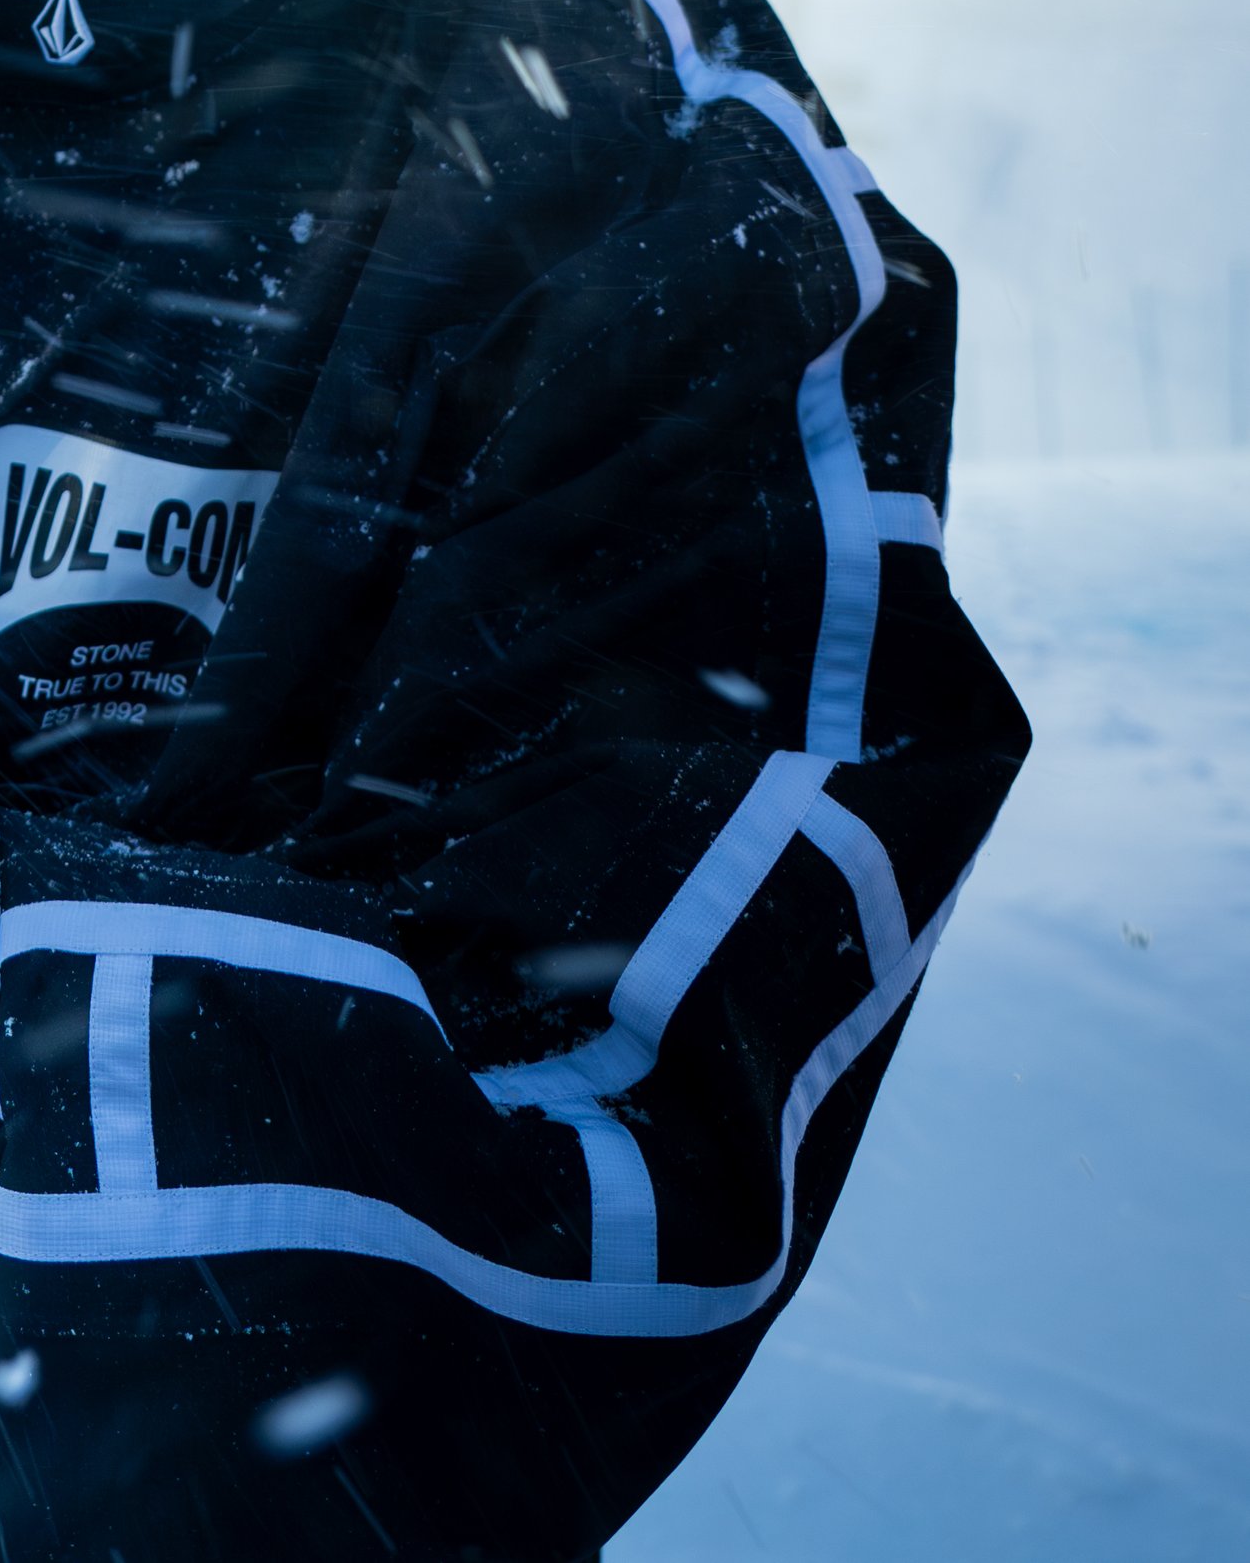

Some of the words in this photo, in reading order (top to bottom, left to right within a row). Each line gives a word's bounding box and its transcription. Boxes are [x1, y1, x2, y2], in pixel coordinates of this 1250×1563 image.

[70, 640, 154, 667] STONE
[18, 672, 85, 700] TRUE
[93, 672, 124, 691] TO
[132, 669, 188, 696] THIS
[41, 704, 87, 729] EST
[91, 701, 147, 725] 1992
